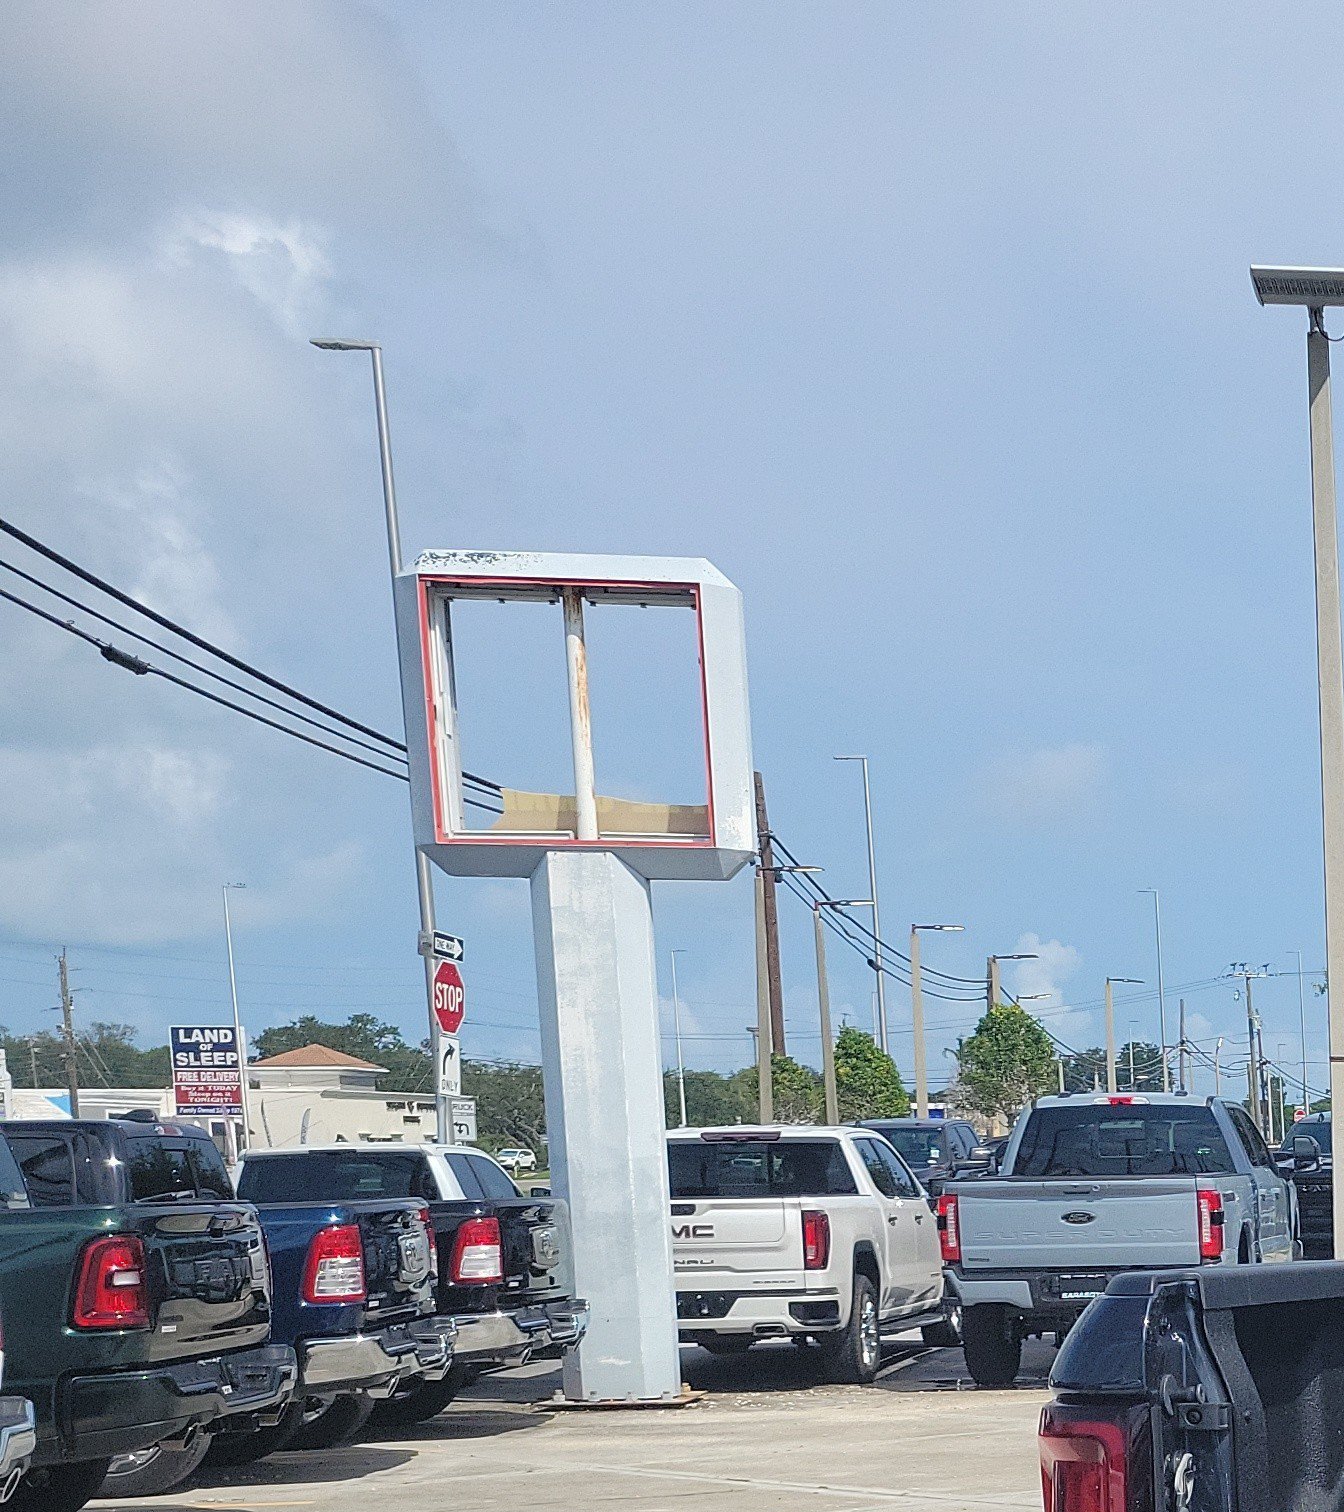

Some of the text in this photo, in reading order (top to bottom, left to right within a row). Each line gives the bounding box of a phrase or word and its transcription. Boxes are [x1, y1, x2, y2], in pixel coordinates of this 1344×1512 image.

[435, 982, 463, 1012] STOP
[178, 1028, 233, 1043] LAND
[199, 1043, 213, 1051] OF
[175, 1052, 238, 1066] SLEEP
[176, 1071, 240, 1082] FREE DELIVERY
[441, 1078, 458, 1092] ONLY
[452, 1103, 474, 1111] RUCK
[671, 1225, 714, 1239] MC
[973, 1228, 1186, 1240] SUPER DUTY
